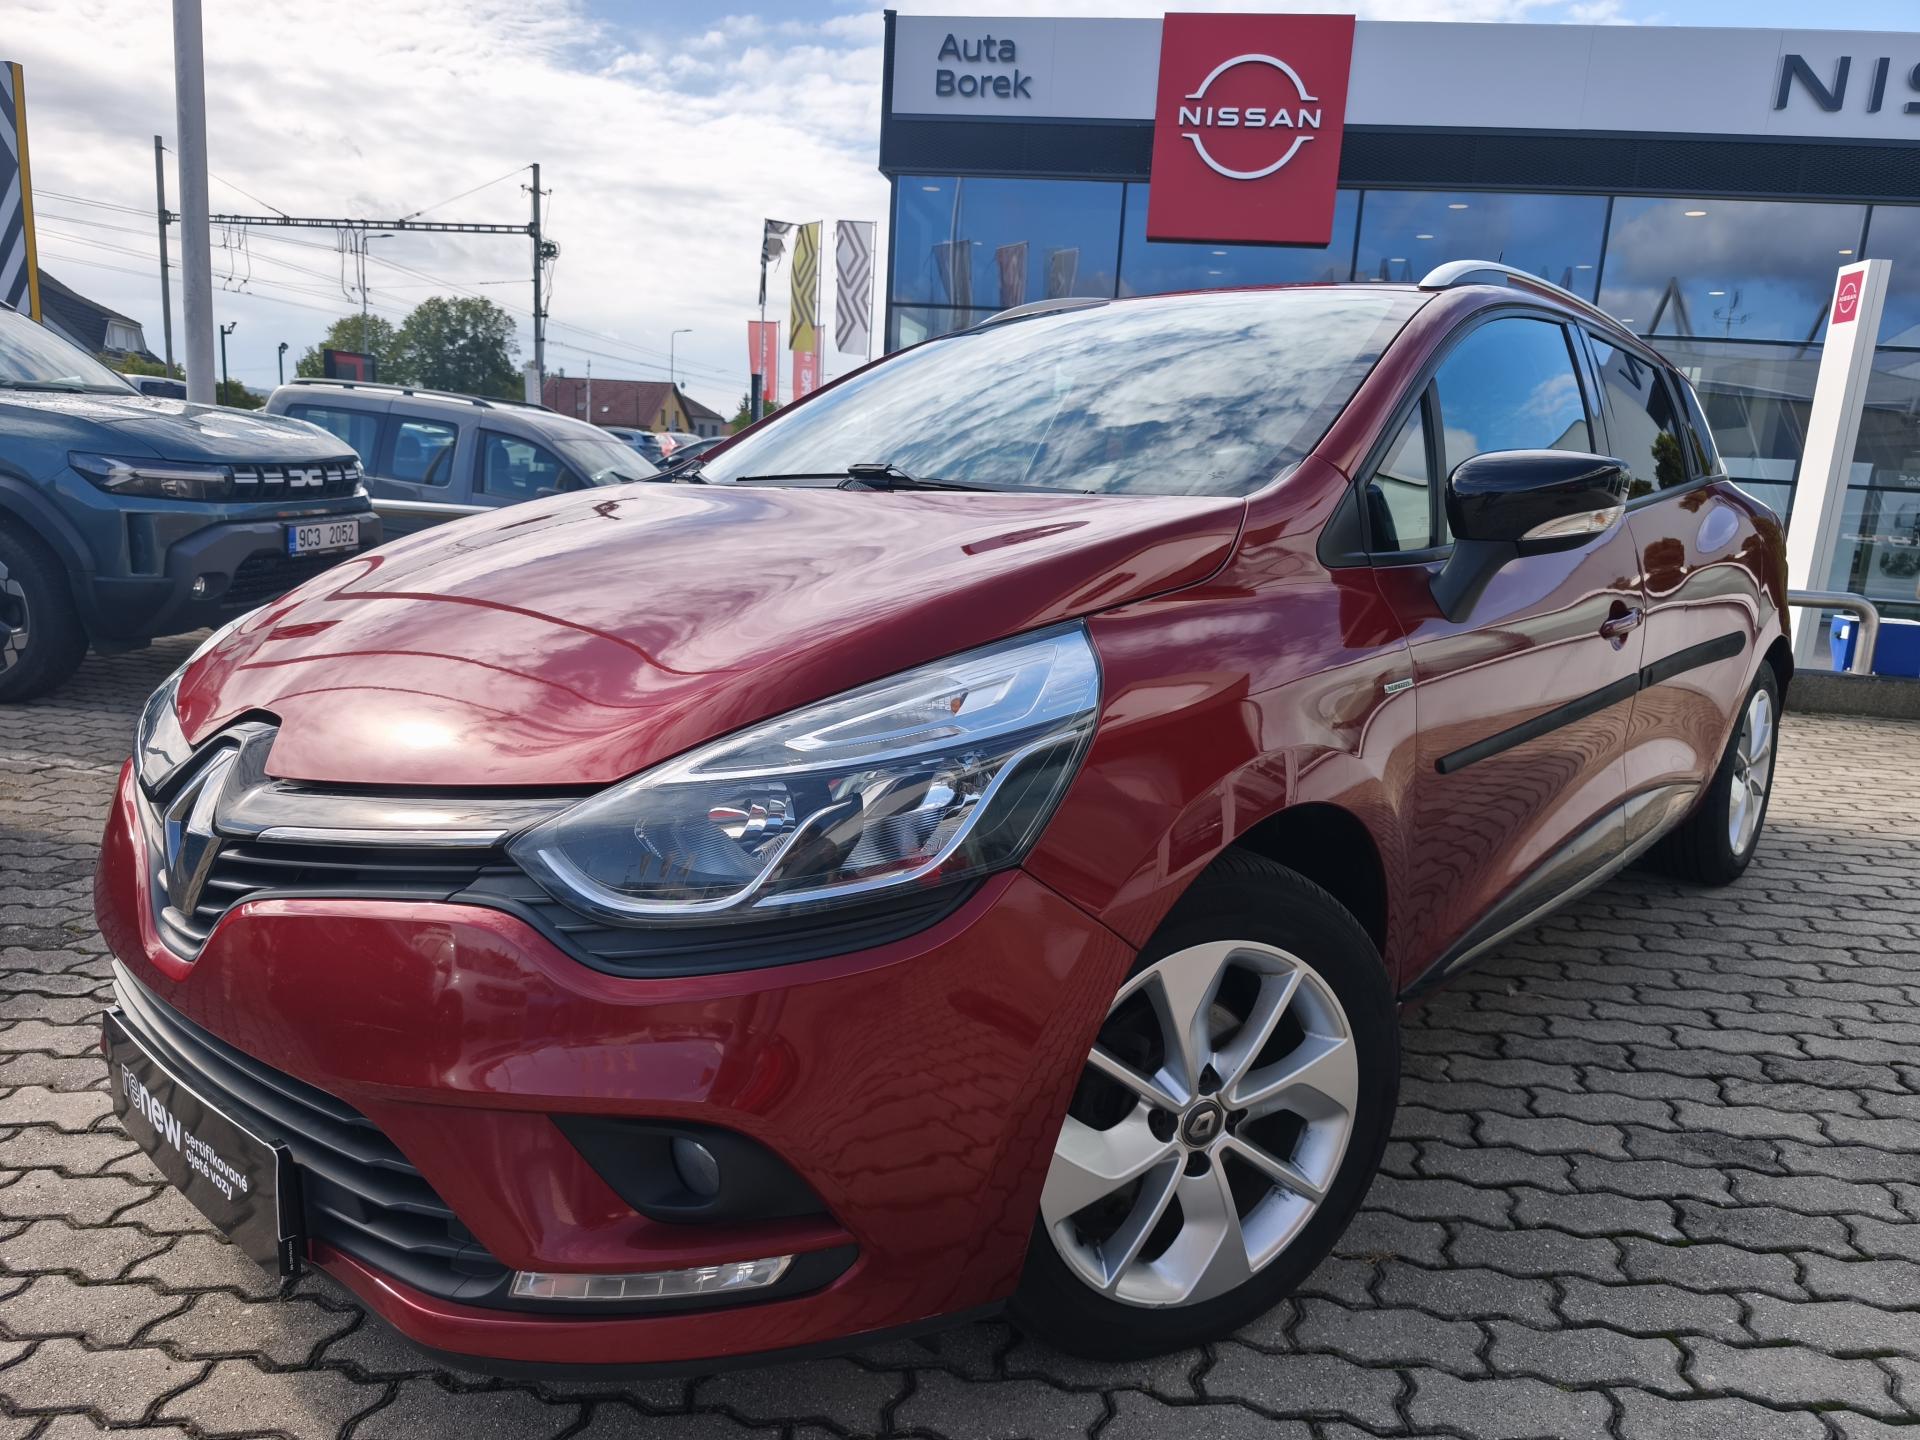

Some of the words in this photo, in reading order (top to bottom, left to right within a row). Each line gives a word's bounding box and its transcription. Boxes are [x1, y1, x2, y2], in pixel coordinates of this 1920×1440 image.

[938, 33, 1016, 62] Auta
[936, 69, 1032, 99] Borek
[1773, 54, 1920, 114] NI
[1179, 106, 1321, 129] NISSAN
[299, 528, 321, 548] 9C3
[329, 524, 354, 545] 2052
[121, 1063, 181, 1152] renew
[184, 1131, 248, 1193] certifikované
[185, 1149, 210, 1178] ojeté
[209, 1168, 233, 1201] vozy
